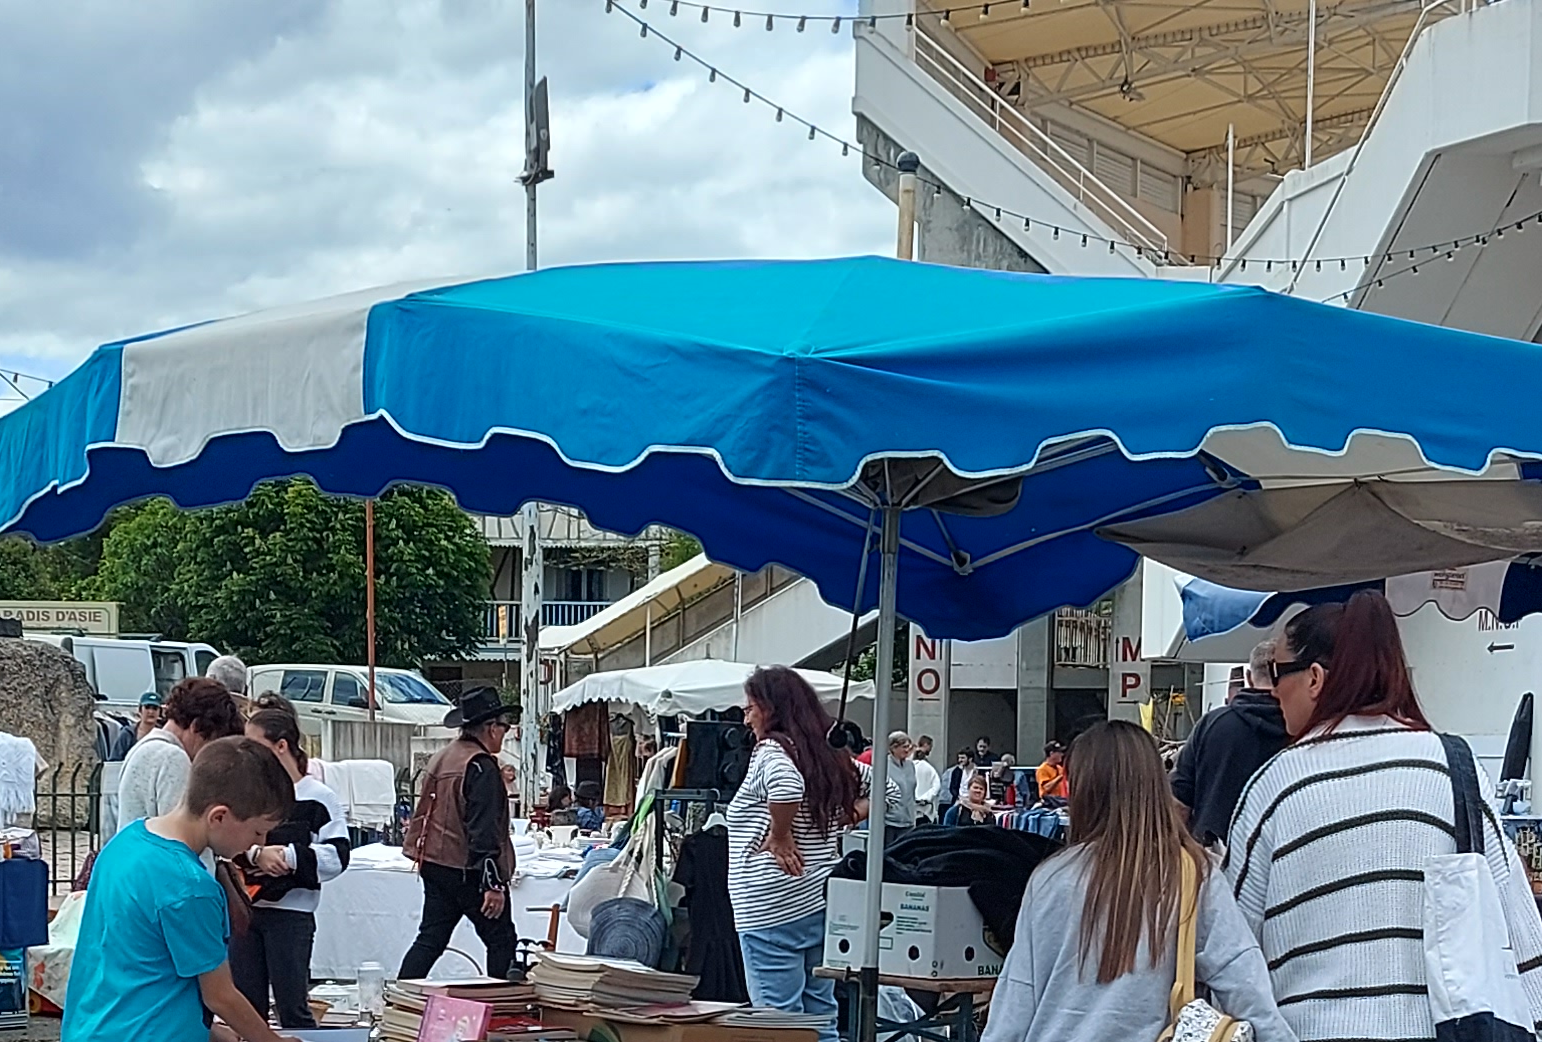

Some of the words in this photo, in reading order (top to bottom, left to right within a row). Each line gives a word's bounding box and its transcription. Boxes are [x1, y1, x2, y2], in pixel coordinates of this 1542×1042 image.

[56, 610, 102, 623] D'ASIE
[915, 634, 937, 661] N
[1121, 636, 1142, 662] M
[916, 668, 941, 694] O
[1121, 672, 1141, 698] P
